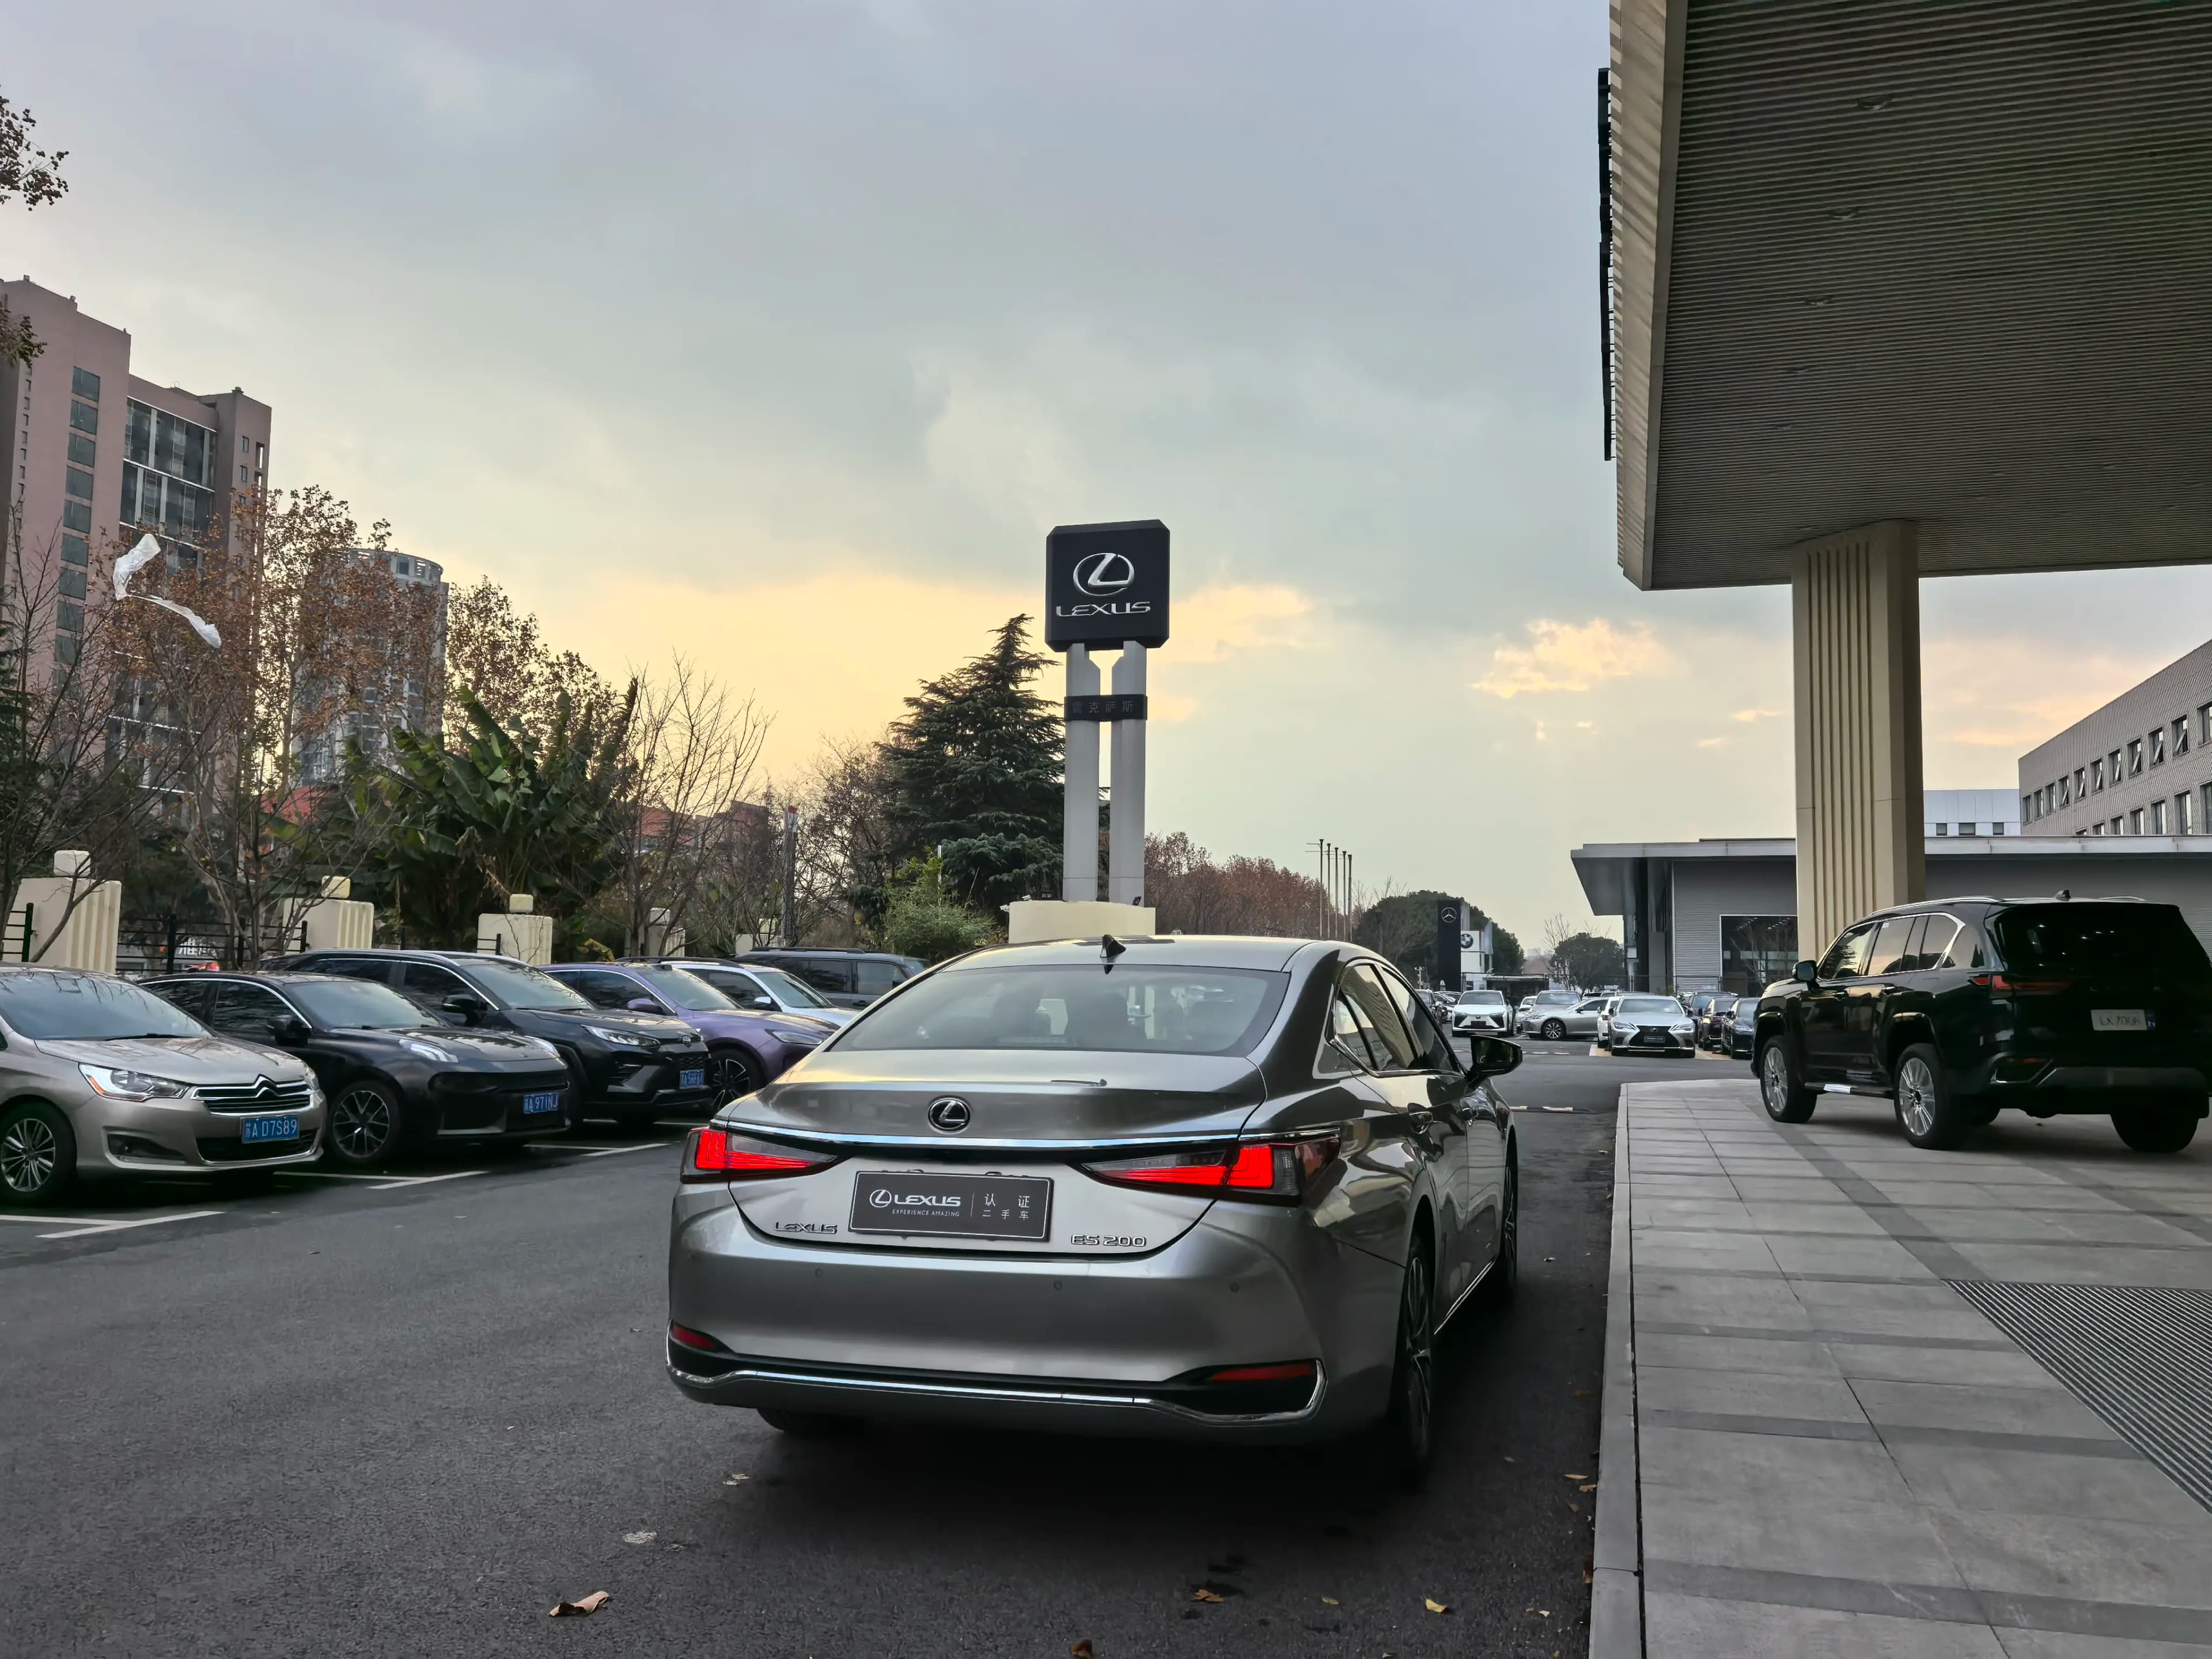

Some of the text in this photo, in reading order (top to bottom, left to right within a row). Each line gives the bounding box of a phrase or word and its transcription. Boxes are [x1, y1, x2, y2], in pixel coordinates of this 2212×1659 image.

[1055, 601, 1151, 617] LEXUS
[1072, 700, 1134, 715] 雷克萨斯
[894, 1194, 961, 1207] LEXUS
[774, 1221, 838, 1234] LEXUS
[1070, 1234, 1147, 1247] ES 200
